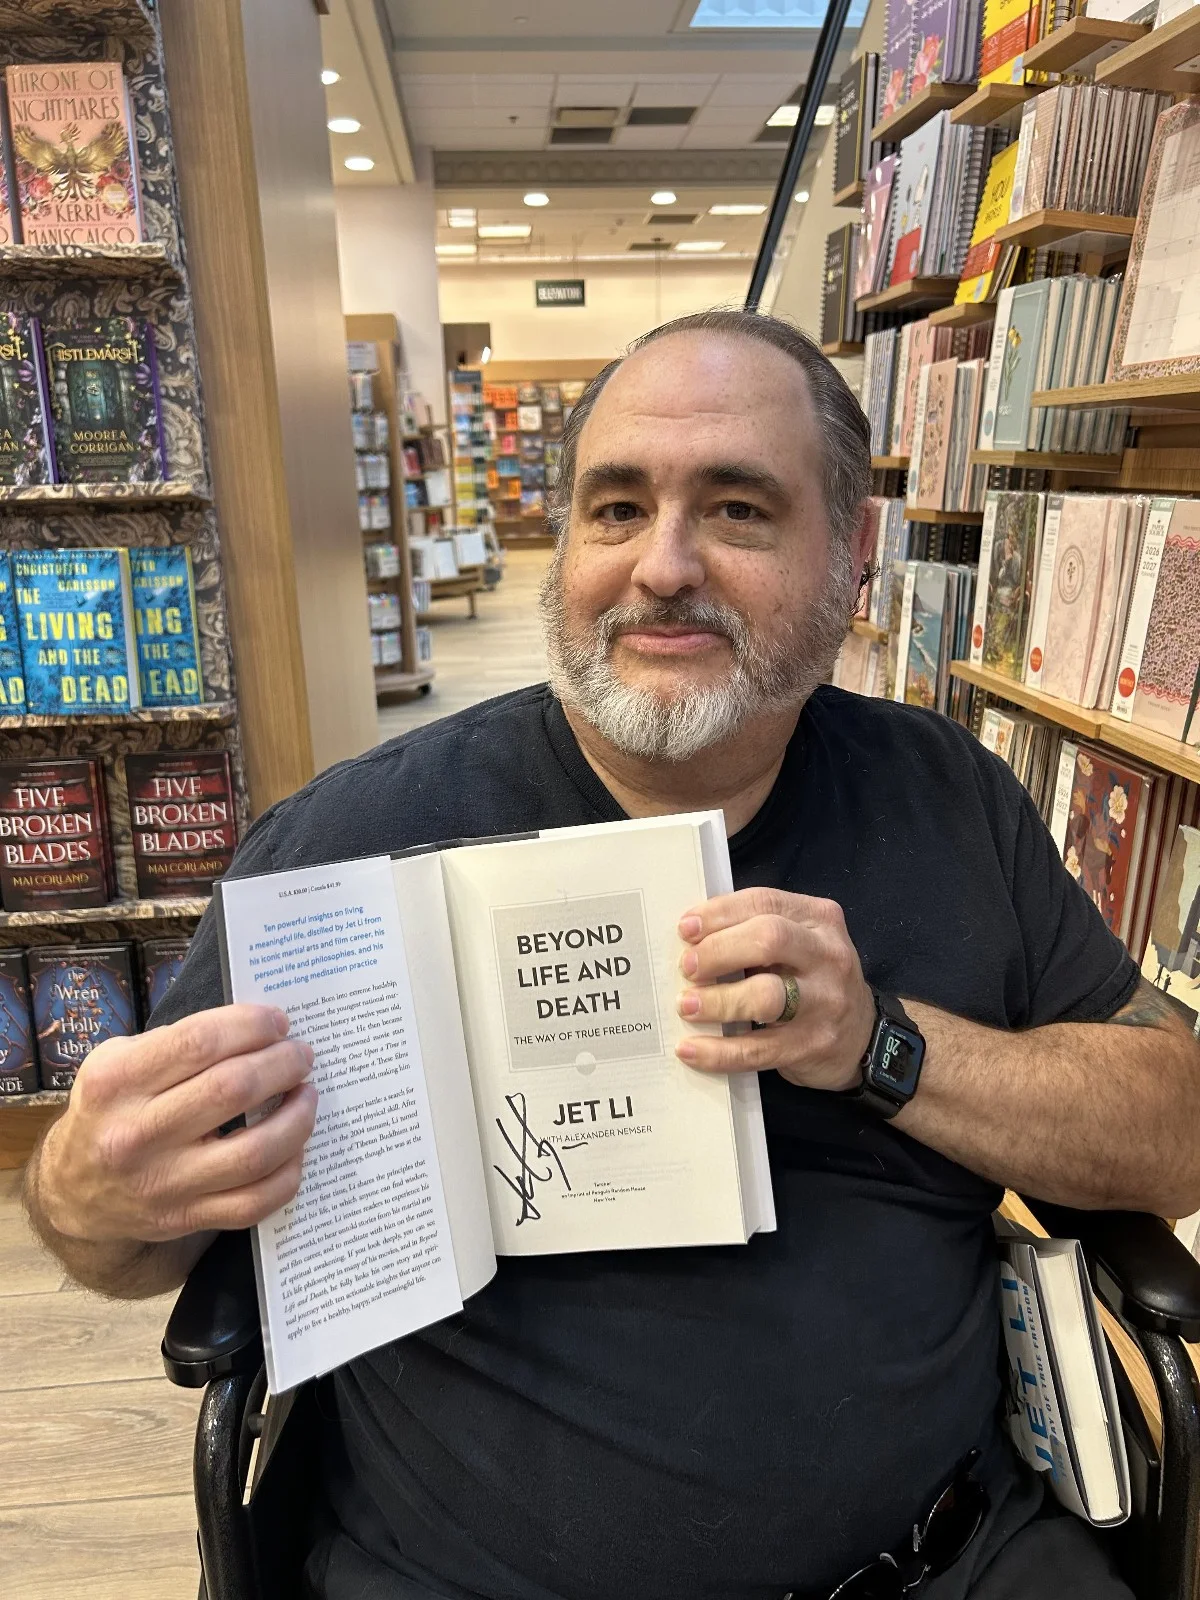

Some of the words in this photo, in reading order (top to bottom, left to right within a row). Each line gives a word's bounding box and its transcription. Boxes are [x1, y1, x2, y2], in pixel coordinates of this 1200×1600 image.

[11, 70, 81, 93] THRONE
[88, 69, 118, 90] OF
[13, 97, 120, 122] NIGHTMARES
[55, 203, 100, 222] KERRI
[73, 430, 128, 441] MOOREA
[70, 442, 134, 454] CORRIGAN
[1145, 546, 1159, 556] 2026
[16, 563, 88, 576] CHRISTOFFER
[1142, 562, 1156, 571] 2027
[16, 588, 40, 605] THE
[58, 579, 115, 592] CARLSSON
[25, 612, 113, 641] LIVING
[38, 649, 68, 666] AND
[74, 648, 100, 665] THE
[143, 643, 170, 660] THE
[61, 675, 128, 704] DEAD
[14, 787, 65, 808] FIVE
[153, 777, 202, 797] FIVE
[0, 812, 92, 839] BROKEN
[135, 802, 227, 826] BROKEN
[141, 829, 226, 852] BLADES
[5, 841, 91, 865] BLADES
[149, 863, 168, 874] MAI
[170, 860, 223, 873] CORLAND
[13, 876, 33, 887] MAI
[35, 872, 89, 885] CORLAND
[263, 924, 276, 932] Ten
[277, 916, 306, 930] powerful
[307, 912, 333, 922] insights
[344, 906, 363, 914] living
[255, 934, 292, 949] meaningful
[307, 925, 333, 937] distilled
[334, 924, 343, 932] by
[345, 921, 356, 929] Jet
[357, 918, 363, 926] Li
[364, 916, 381, 924] from
[517, 924, 623, 954] BEYOND
[249, 957, 260, 966] his
[260, 952, 280, 963] iconic
[281, 945, 305, 957] martial
[306, 943, 319, 952] arts
[320, 938, 333, 948] and
[334, 937, 348, 945] film
[349, 932, 373, 942] career,
[374, 928, 385, 936] his
[254, 965, 284, 981] personal
[284, 962, 295, 971] life
[296, 958, 310, 969] and
[310, 949, 356, 966] philosophies,
[358, 944, 372, 954] and
[372, 942, 383, 951] his
[518, 964, 570, 988] LIFE
[578, 956, 631, 982] AND
[68, 969, 84, 980] the
[263, 975, 309, 992] decades-long
[310, 965, 347, 979] meditation
[349, 958, 377, 972] practice
[54, 984, 99, 1000] Wren
[326, 1007, 336, 1015] the
[336, 1001, 361, 1015] youngest
[362, 994, 384, 1006] national
[536, 990, 621, 1019] DEATH
[61, 1017, 101, 1036] Holly
[514, 1036, 533, 1045] THE
[535, 1034, 556, 1044] WAY
[558, 1032, 573, 1042] OF
[575, 1028, 600, 1039] TRUE
[602, 1022, 652, 1036] FREEDOM
[553, 1100, 600, 1126] JET
[609, 1096, 633, 1119] LI
[540, 1135, 562, 1144] WITH
[564, 1129, 616, 1142] ALEXANDER
[617, 1125, 652, 1136] NEMSER
[295, 1202, 304, 1211] the
[305, 1197, 318, 1206] very
[348, 1183, 356, 1191] Li
[357, 1178, 374, 1188] shares
[375, 1173, 385, 1181] the
[386, 1164, 413, 1179] principles
[414, 1159, 425, 1168] that
[305, 1176, 338, 1193] Hollywood
[304, 1323, 310, 1331] to
[371, 1291, 382, 1302] and
[383, 1278, 415, 1296] meaningful
[1002, 1277, 1027, 1332] LI
[1022, 1284, 1040, 1348] FREEDOM
[1035, 1356, 1048, 1388] TRUE
[1045, 1396, 1054, 1413] OF
[1018, 1356, 1060, 1484] JET
